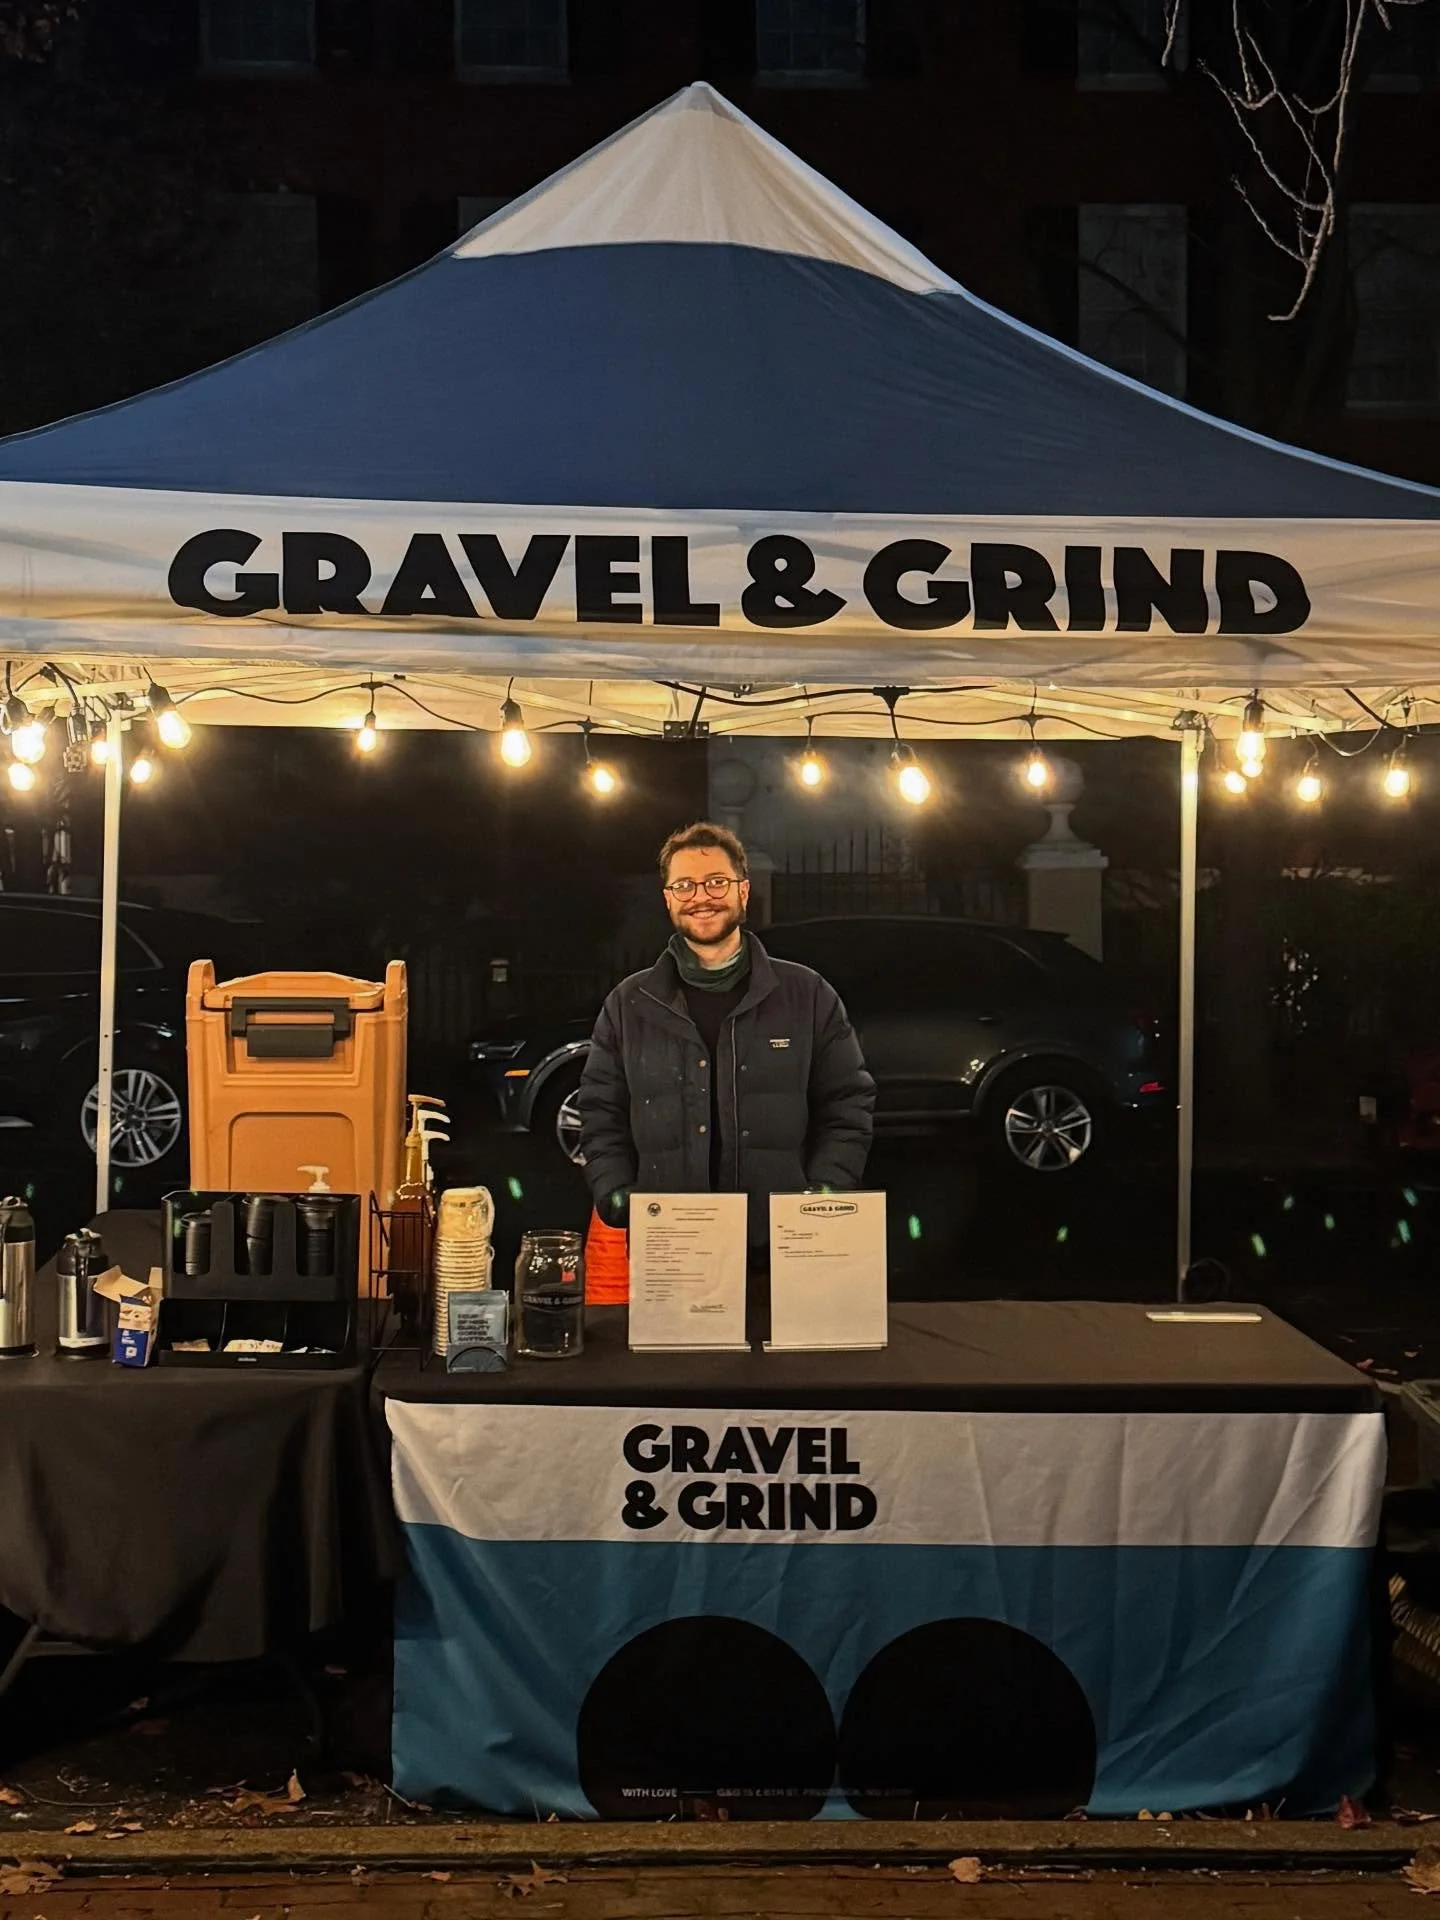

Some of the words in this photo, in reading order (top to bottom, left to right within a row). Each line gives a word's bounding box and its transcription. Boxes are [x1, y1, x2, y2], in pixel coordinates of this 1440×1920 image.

[167, 528, 721, 627] GRAVEL
[741, 534, 848, 628] &
[863, 538, 1311, 635] GRIND
[623, 1423, 860, 1475] GRAVEL
[621, 1480, 669, 1530] &
[677, 1480, 878, 1531] GRIND
[621, 1788, 649, 1797] WITH
[651, 1788, 677, 1797] LOVE
